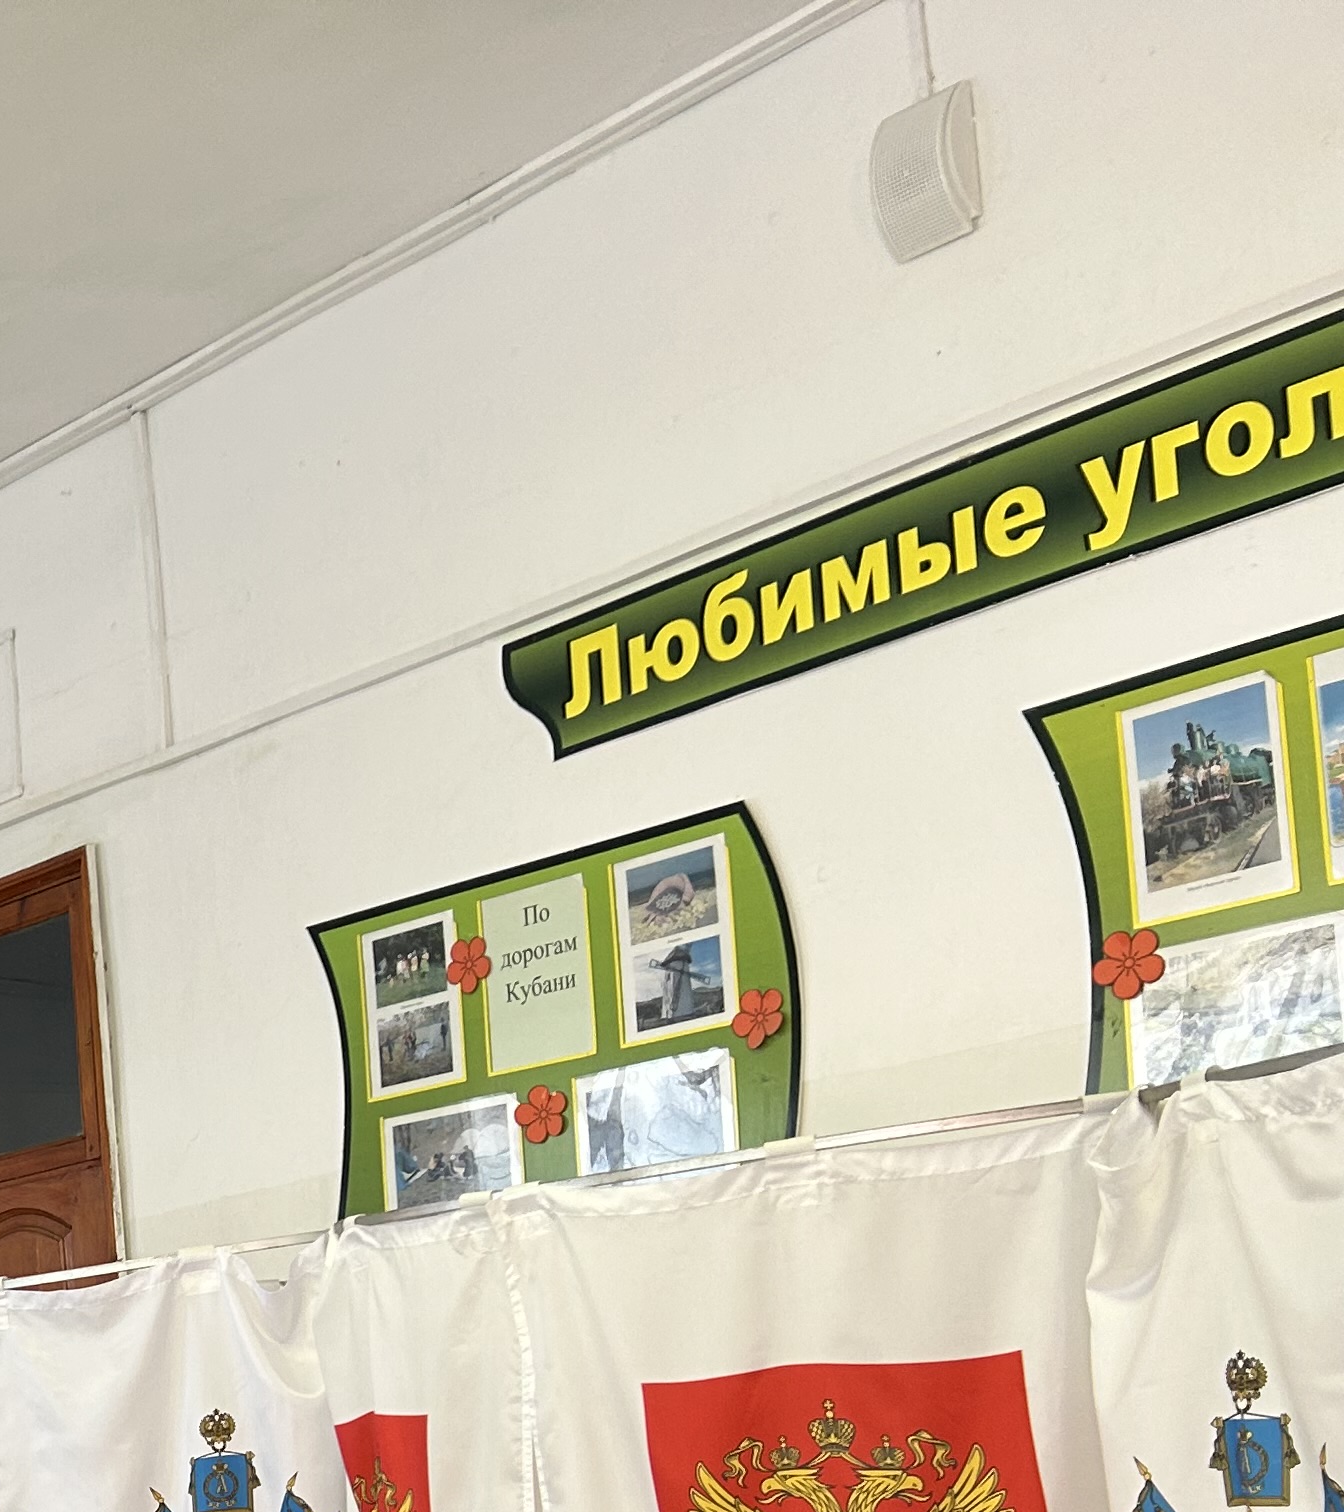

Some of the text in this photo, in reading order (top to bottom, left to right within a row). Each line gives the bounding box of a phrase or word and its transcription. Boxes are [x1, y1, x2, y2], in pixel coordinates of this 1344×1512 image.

[562, 367, 1344, 720] Любимые угол
[522, 903, 551, 928] По
[499, 935, 579, 972] дорогам
[504, 973, 577, 1006] Кубани
